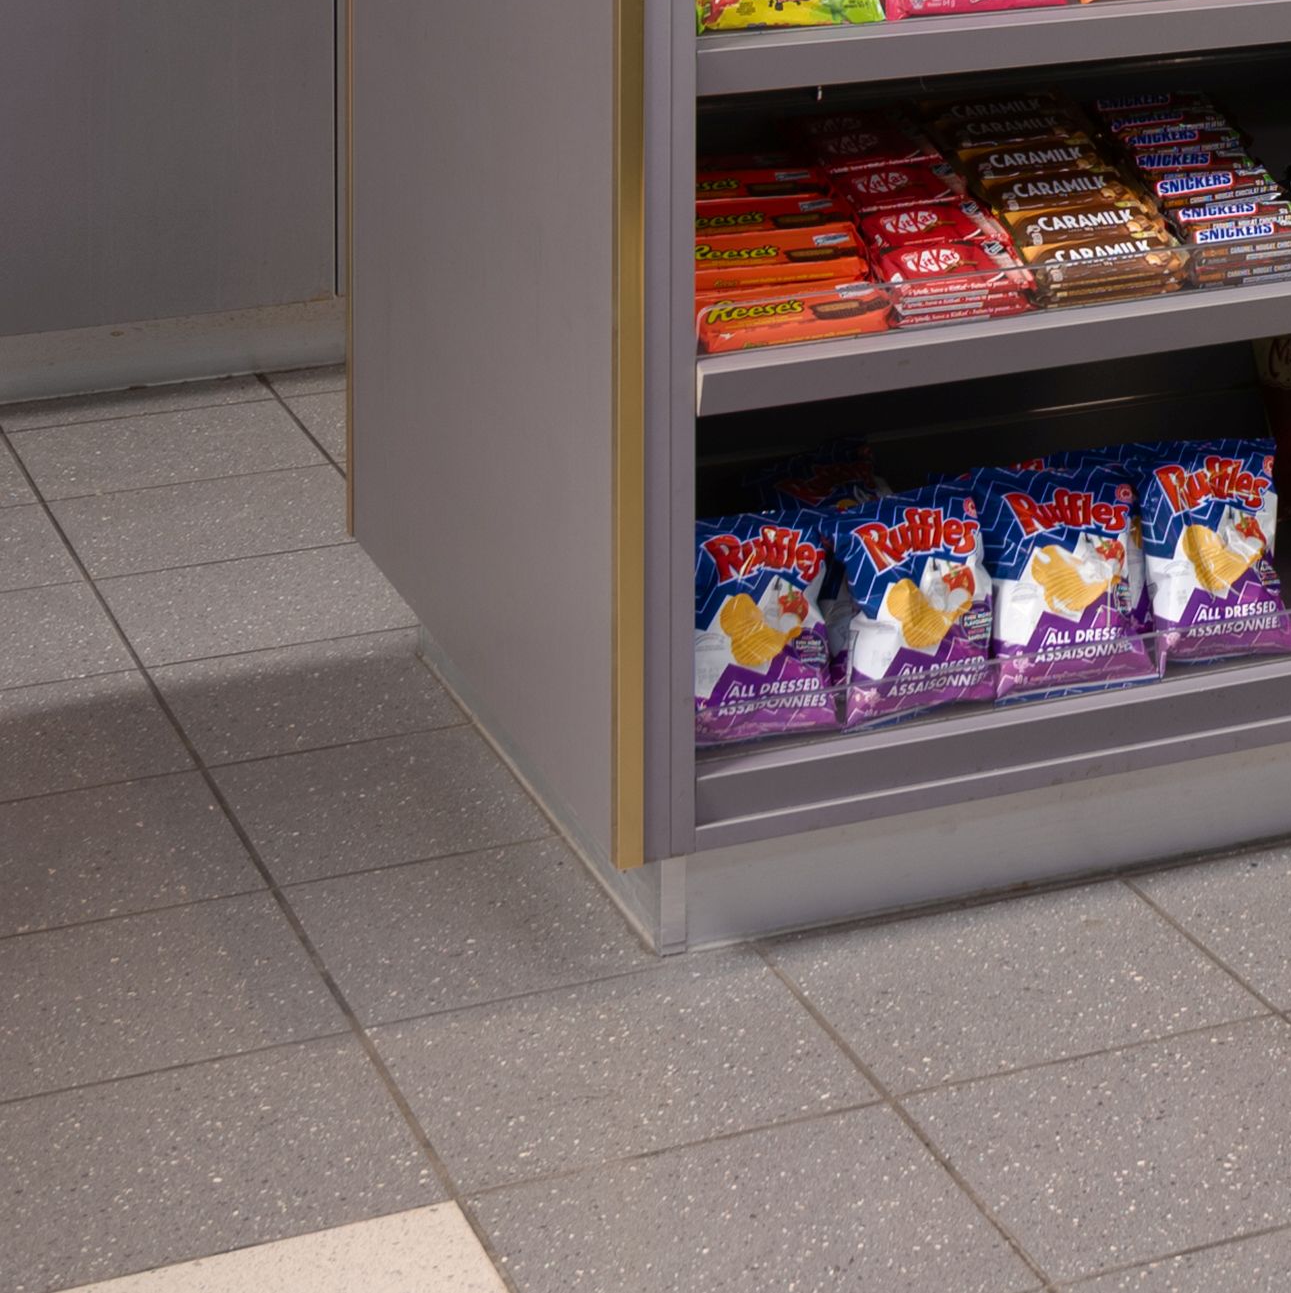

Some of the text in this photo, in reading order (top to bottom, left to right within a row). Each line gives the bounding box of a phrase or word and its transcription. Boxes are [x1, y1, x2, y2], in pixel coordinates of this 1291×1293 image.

[1125, 128, 1199, 147] SNICKERS
[989, 145, 1083, 168] CARAMILK
[1138, 152, 1210, 168] SNICKERS
[695, 178, 740, 191] ese's
[1012, 174, 1107, 199] CARAMILK
[1157, 171, 1233, 196] SNICKERS
[695, 211, 765, 227] eese's
[1037, 208, 1134, 232] CARAMILK
[1180, 202, 1256, 223] SNICKERS
[694, 244, 779, 259] Reese's
[706, 298, 804, 325] Reese's
[1153, 454, 1272, 516] Ruffles
[1001, 488, 1130, 539] Ruffles
[852, 506, 982, 576] Ruffles
[701, 525, 826, 587] Ruffles
[1196, 601, 1277, 622] ALL DRESSED
[1045, 626, 1122, 646] ALL DRESS
[900, 656, 986, 683] ALL DRESSED
[729, 676, 820, 700] ALL DRESSED
